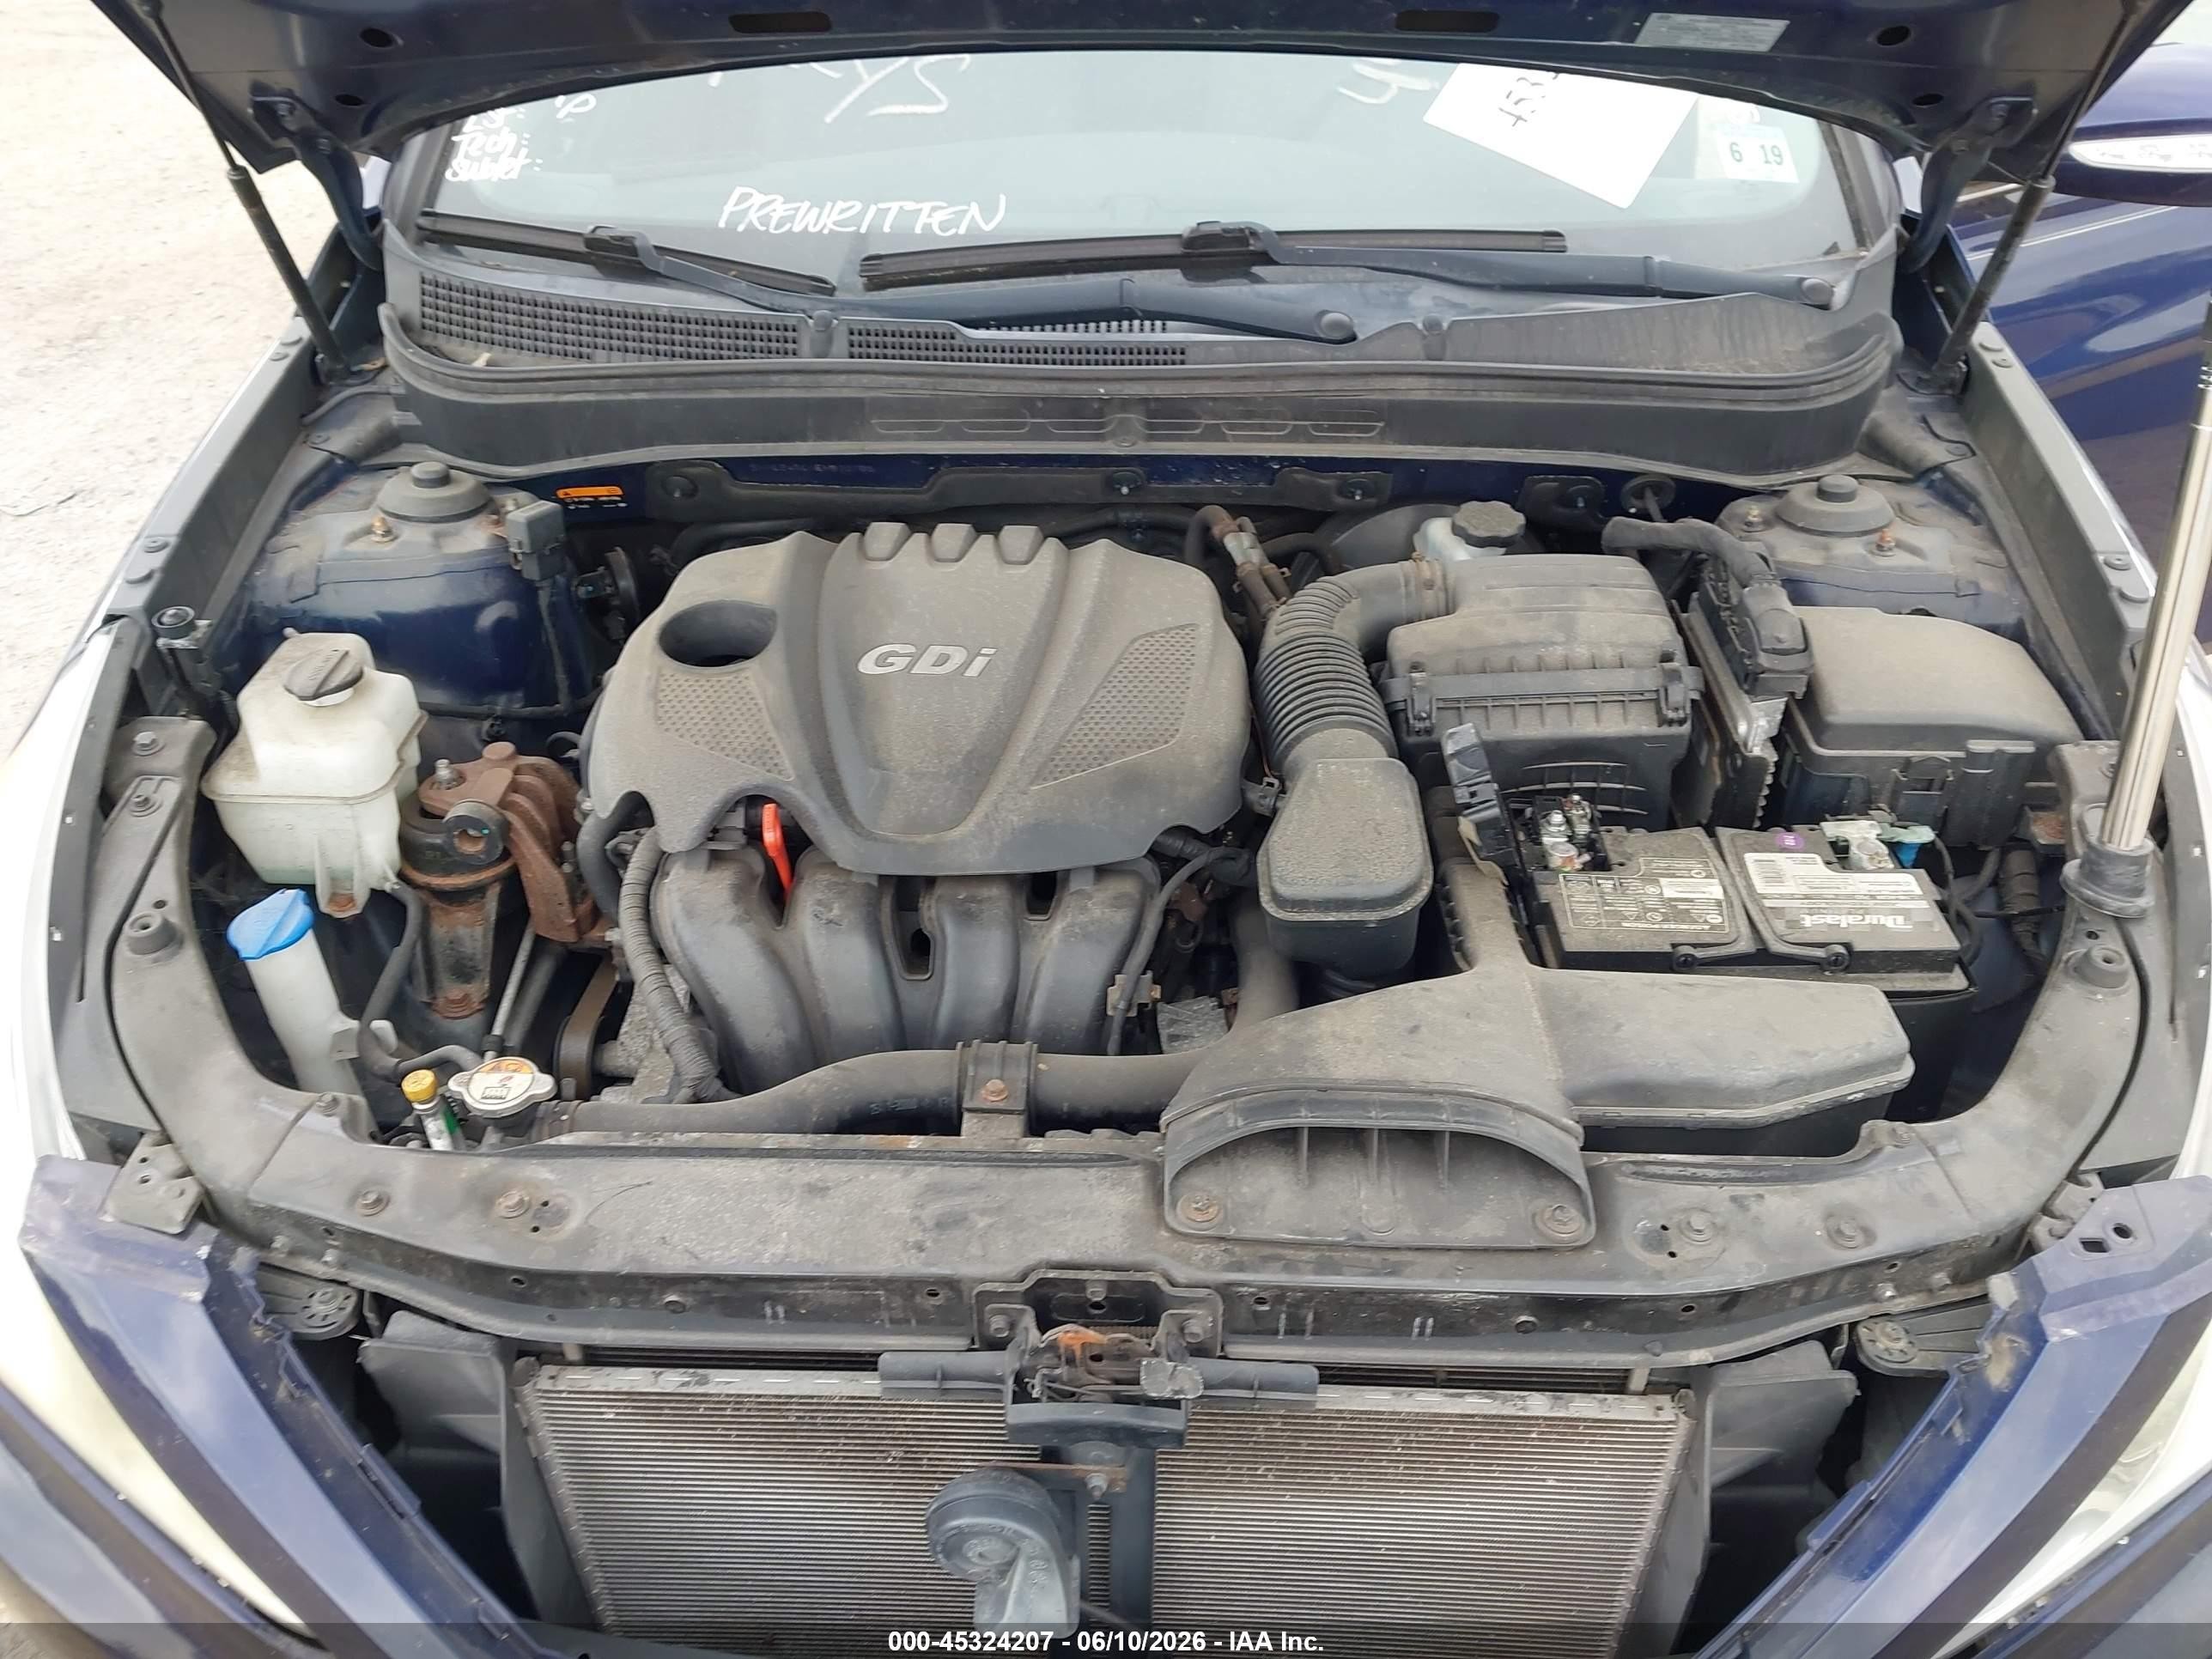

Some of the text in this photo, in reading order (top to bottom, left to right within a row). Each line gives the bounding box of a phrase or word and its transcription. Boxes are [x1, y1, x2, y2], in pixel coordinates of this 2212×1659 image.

[1729, 142, 1784, 166] 6 19
[718, 185, 1006, 236] PREWRITTEN
[857, 643, 998, 678] GDi
[1800, 914, 1913, 927] Duralast
